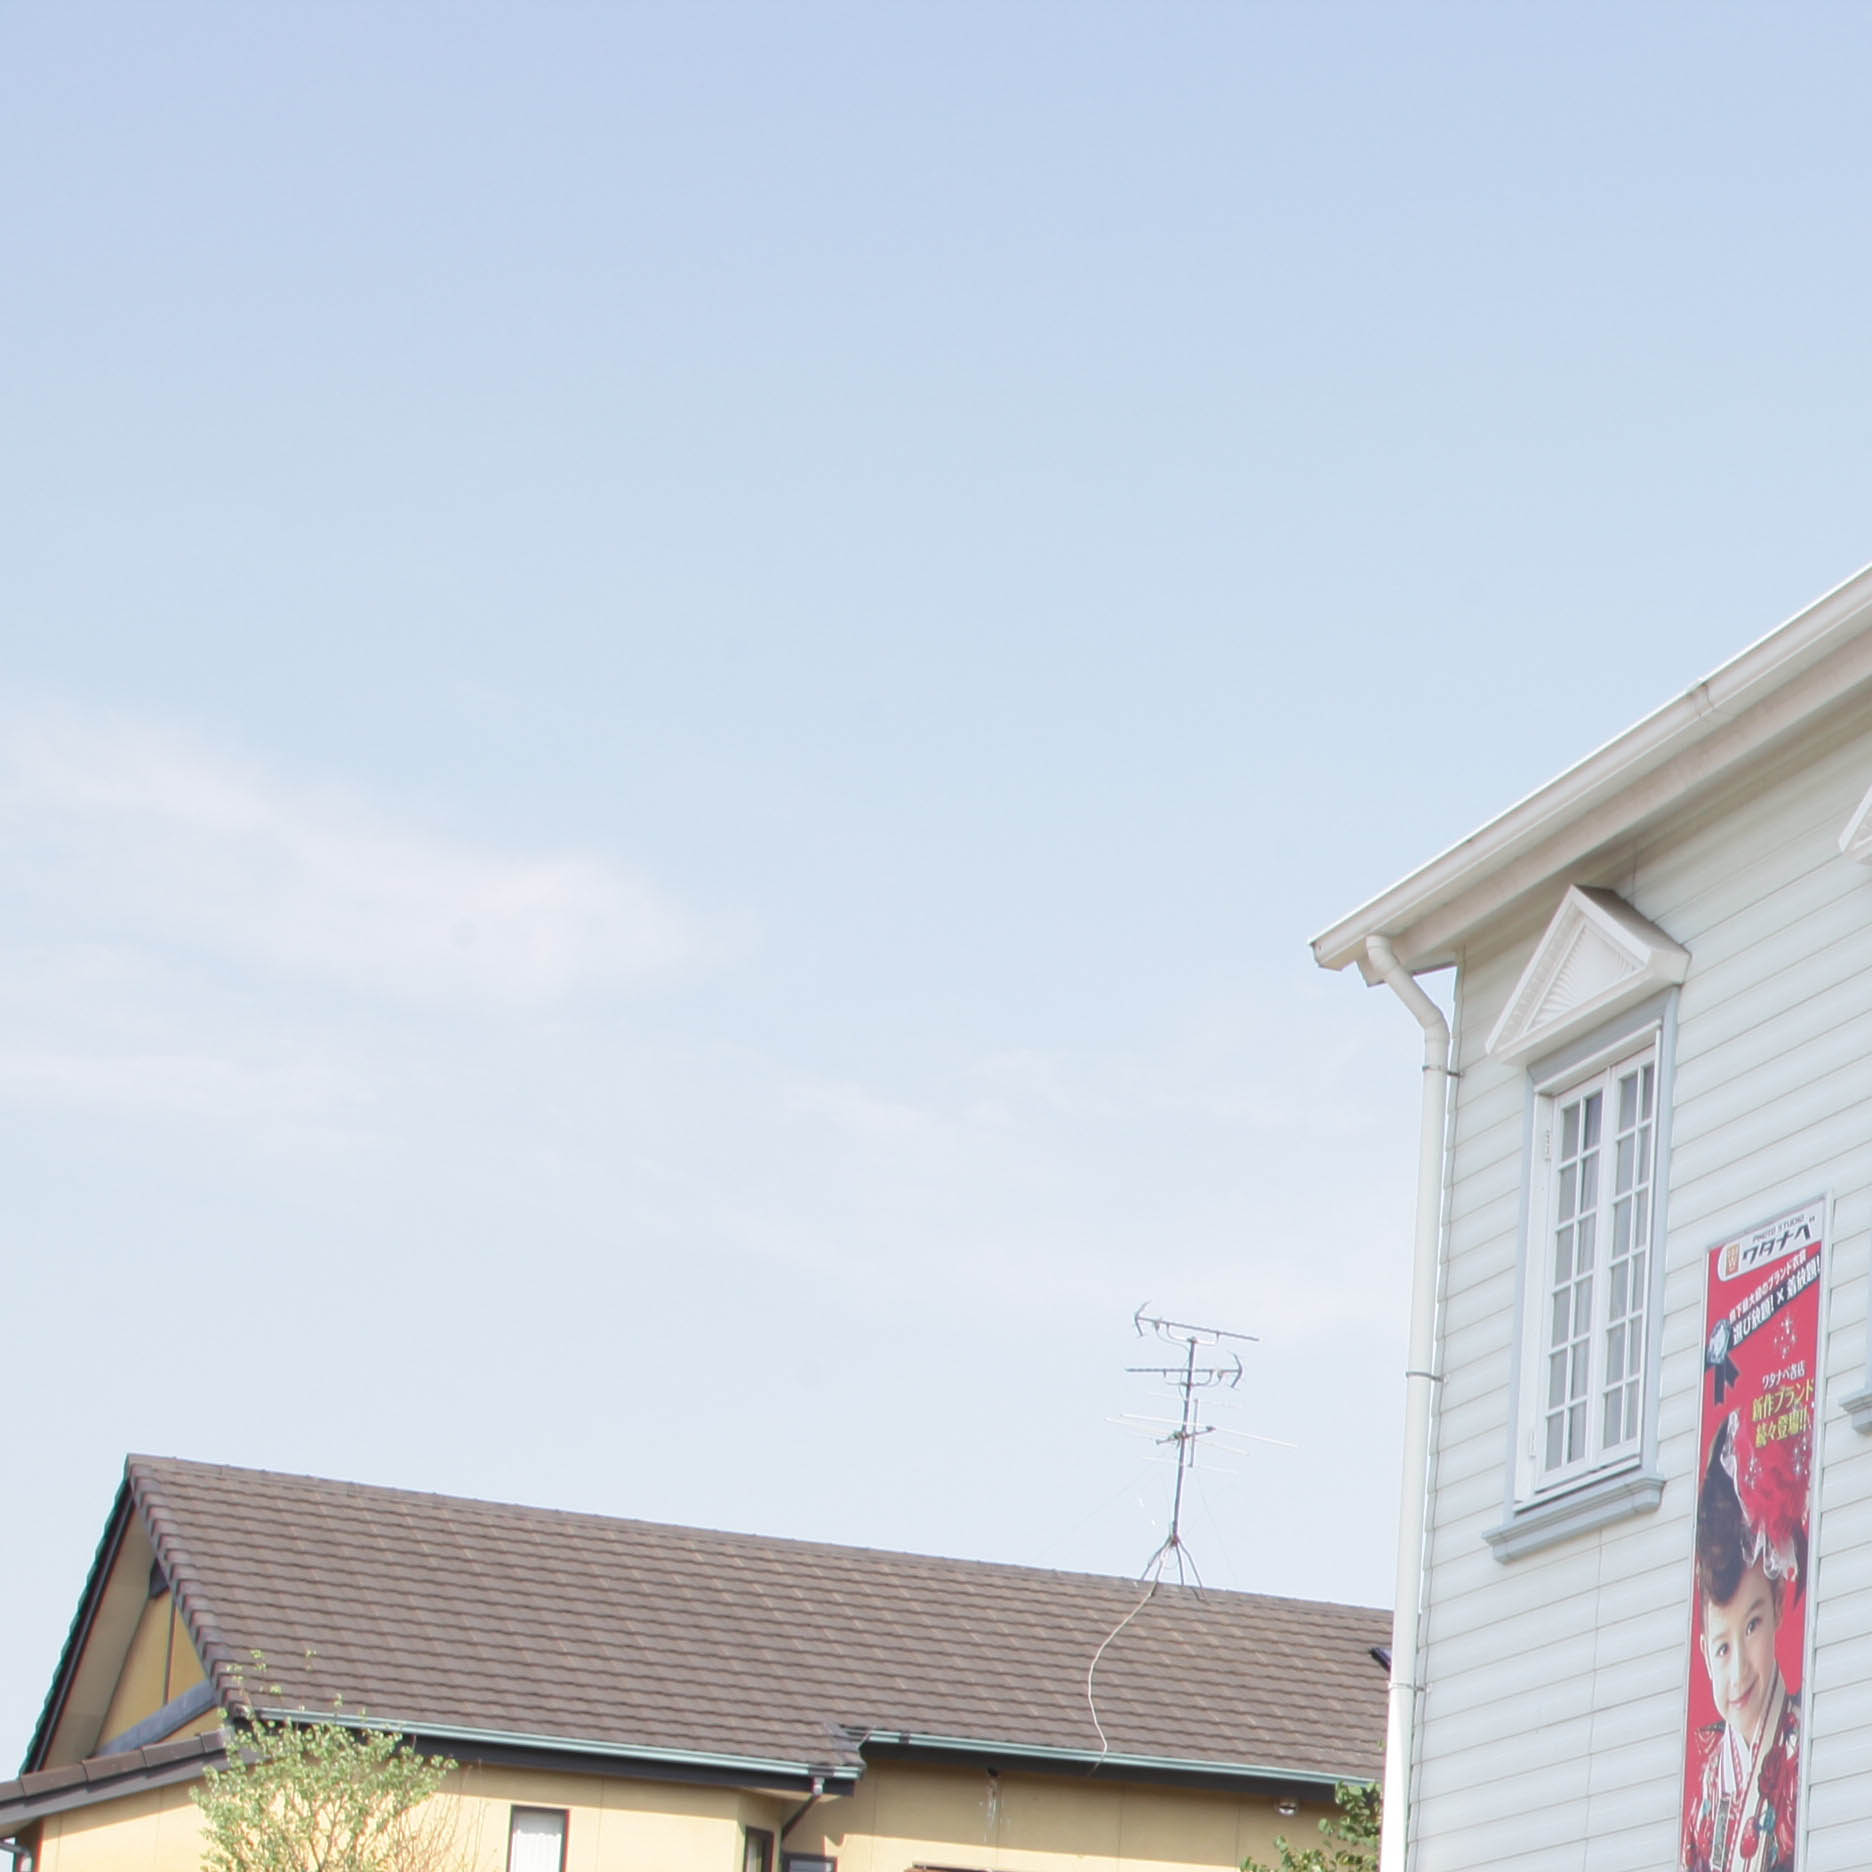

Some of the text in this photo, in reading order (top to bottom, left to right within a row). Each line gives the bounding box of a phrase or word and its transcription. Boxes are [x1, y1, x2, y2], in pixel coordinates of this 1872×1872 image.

[1742, 1216, 1815, 1265] ワタナベ
[1752, 1378, 1815, 1422] 新作ブランド
